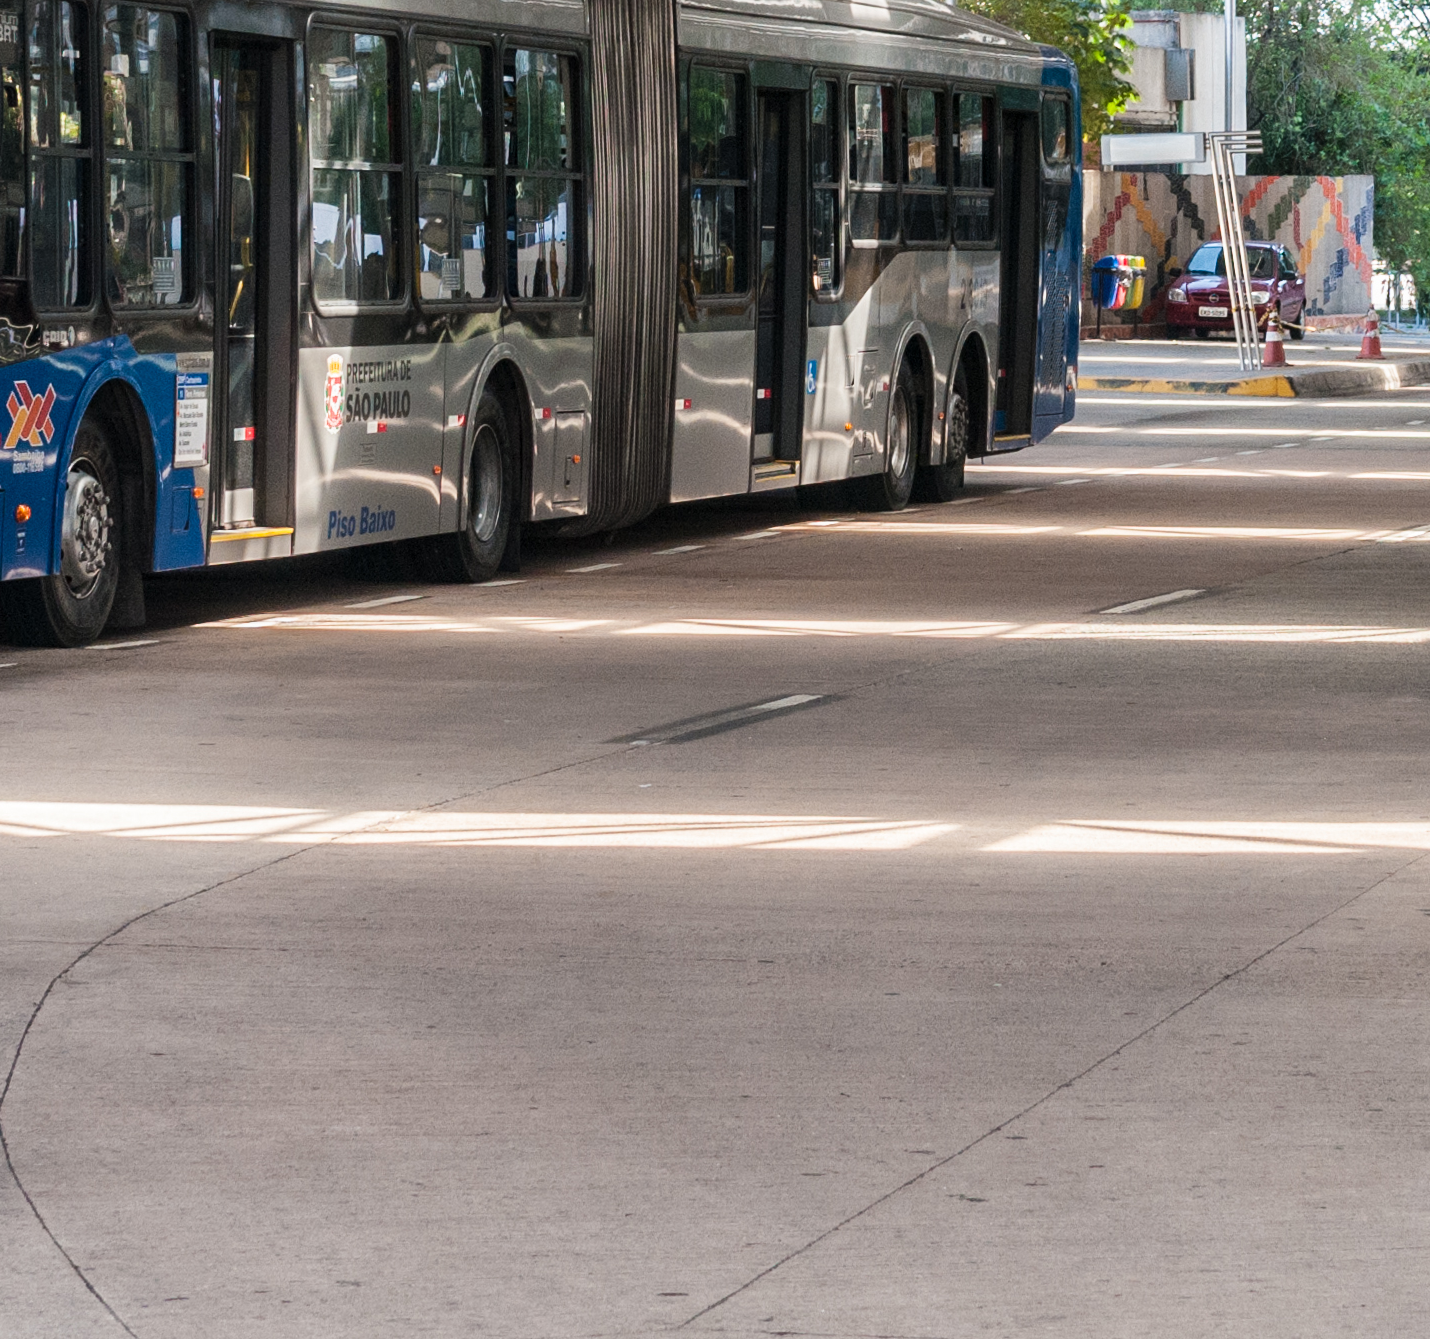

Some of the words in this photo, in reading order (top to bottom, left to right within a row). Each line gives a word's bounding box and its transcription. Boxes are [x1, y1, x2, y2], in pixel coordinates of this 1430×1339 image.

[346, 360, 398, 384] PREFEITURA
[399, 360, 412, 381] DE
[345, 388, 371, 423] SÃO
[372, 389, 411, 420] PAULO
[327, 510, 356, 539] Piso
[359, 505, 396, 535] Baixo
